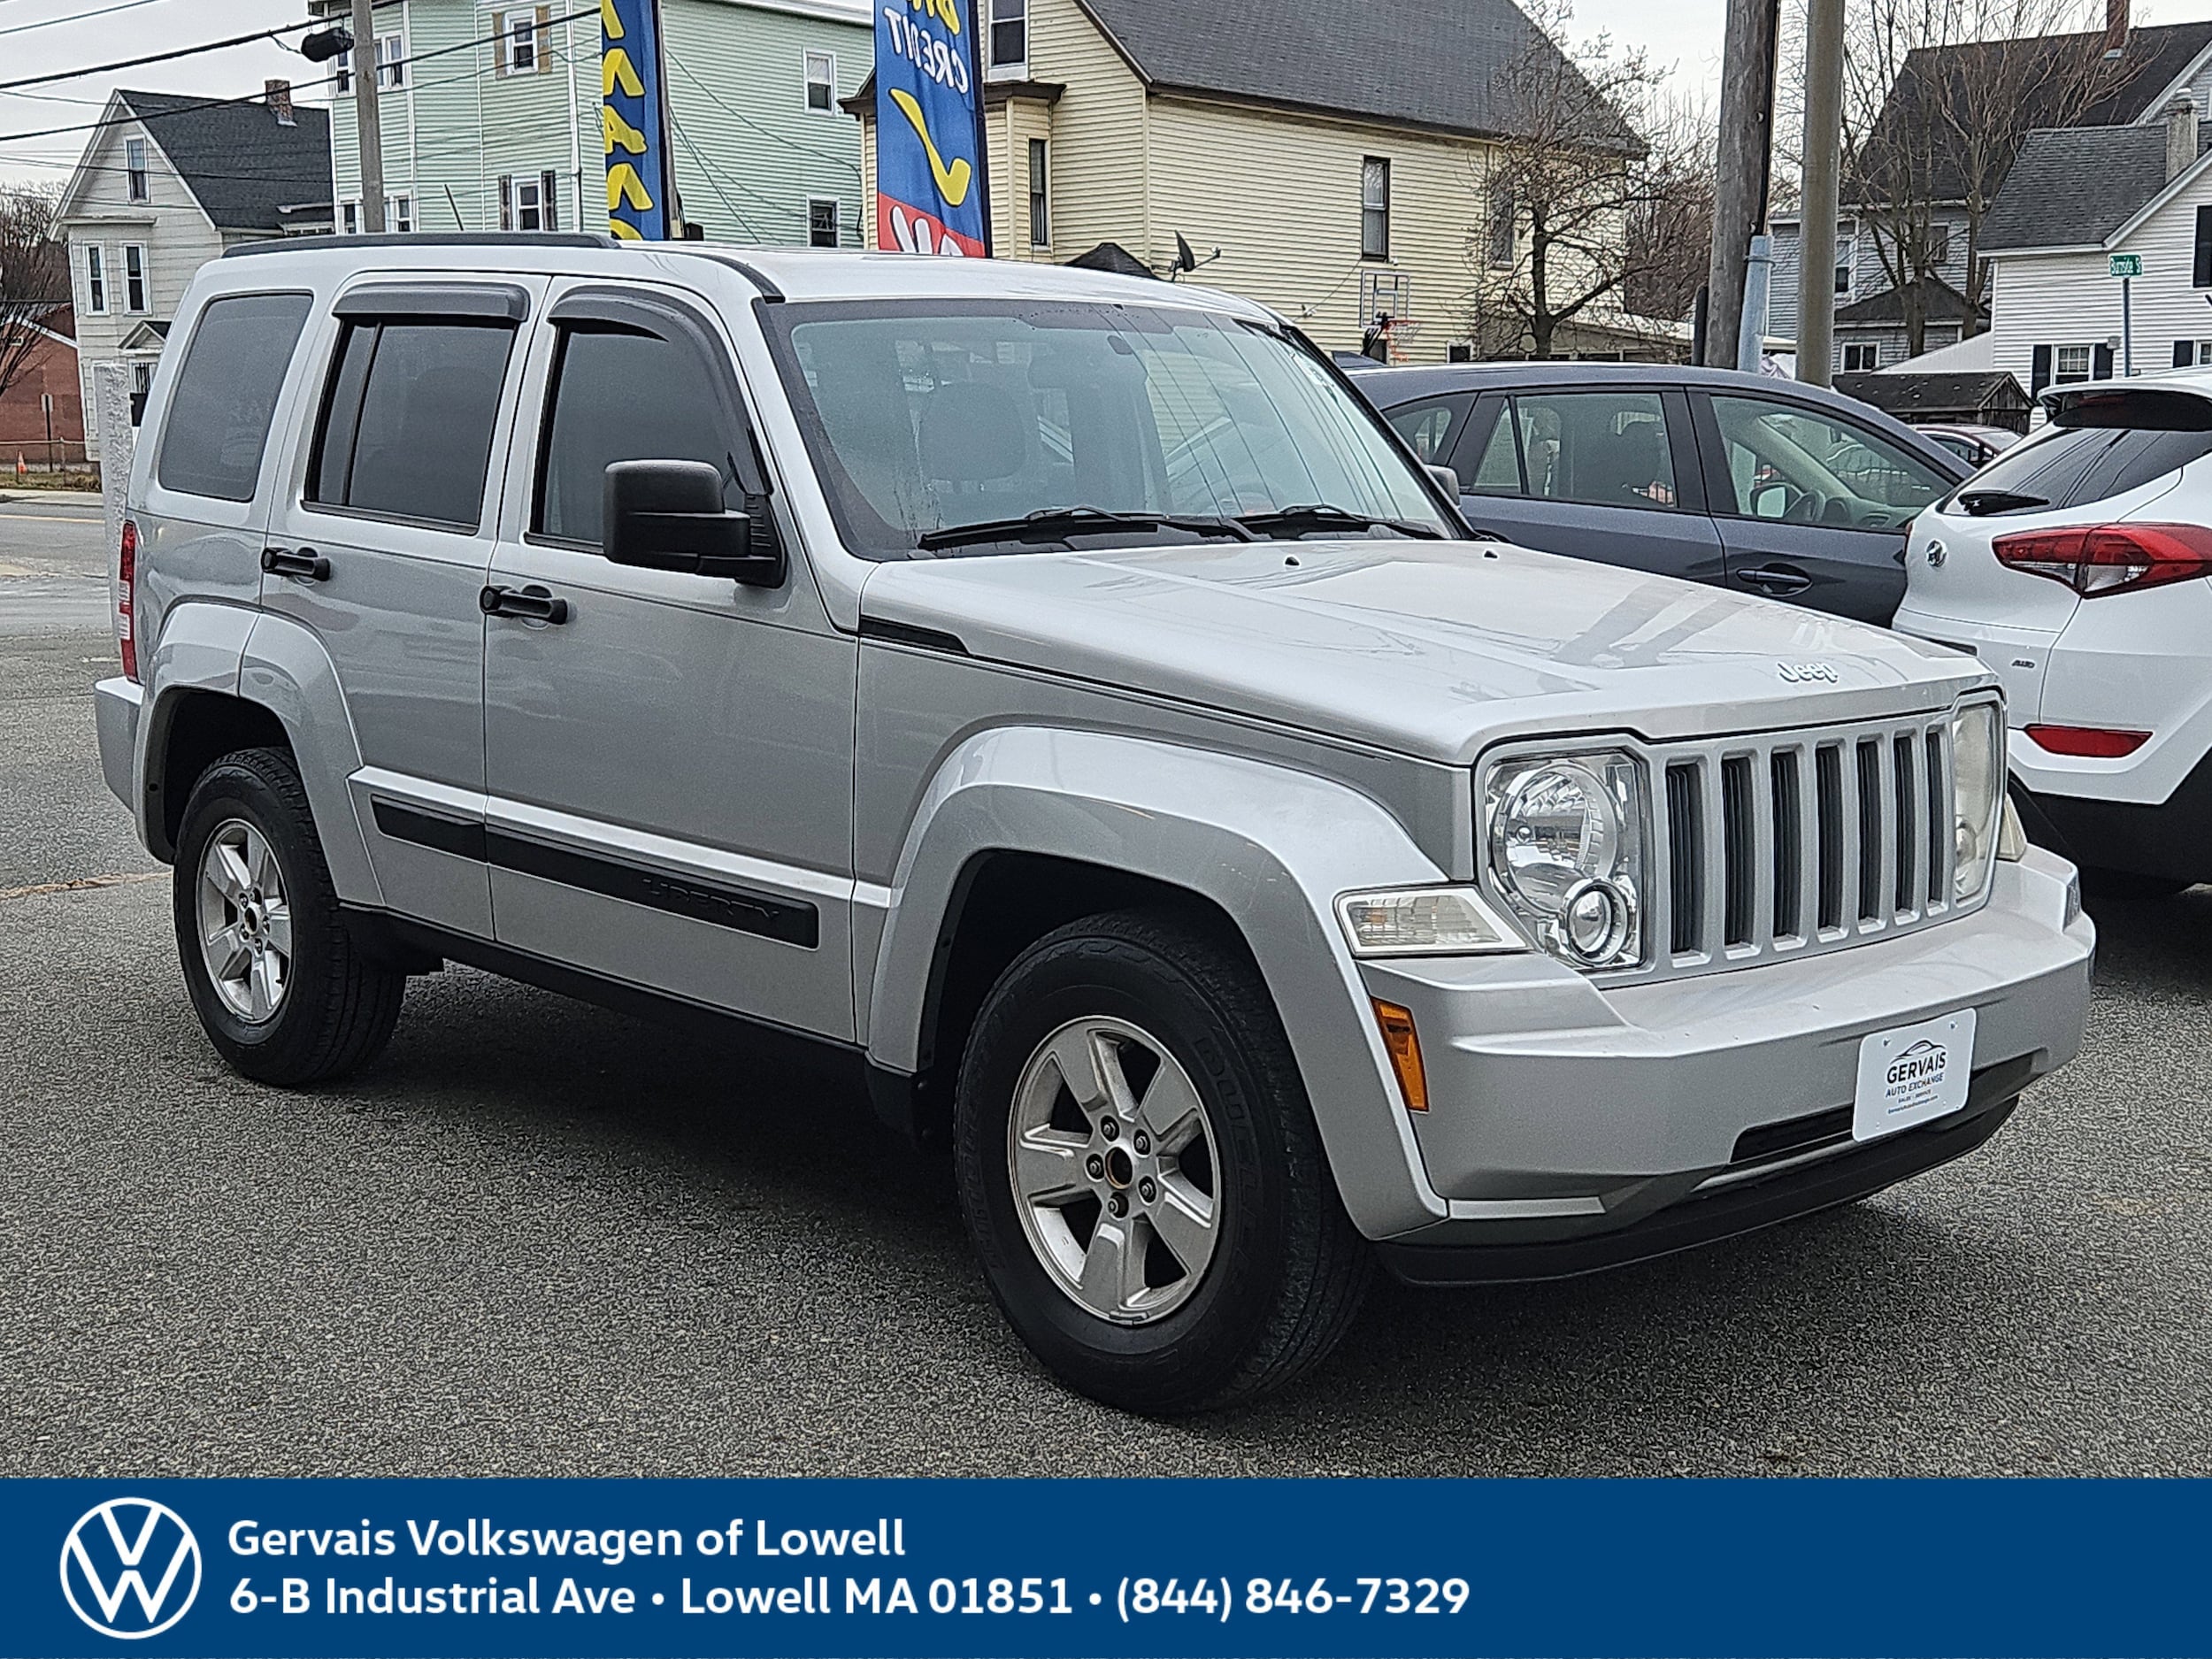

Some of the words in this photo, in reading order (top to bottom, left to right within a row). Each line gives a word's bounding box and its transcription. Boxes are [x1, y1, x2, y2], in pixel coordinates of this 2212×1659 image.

[1777, 661, 1838, 684] Jeep
[1886, 1052, 1947, 1084] GERVAIS
[1886, 1085, 1906, 1098] AUTO
[1908, 1071, 1945, 1092] EXCHANGE
